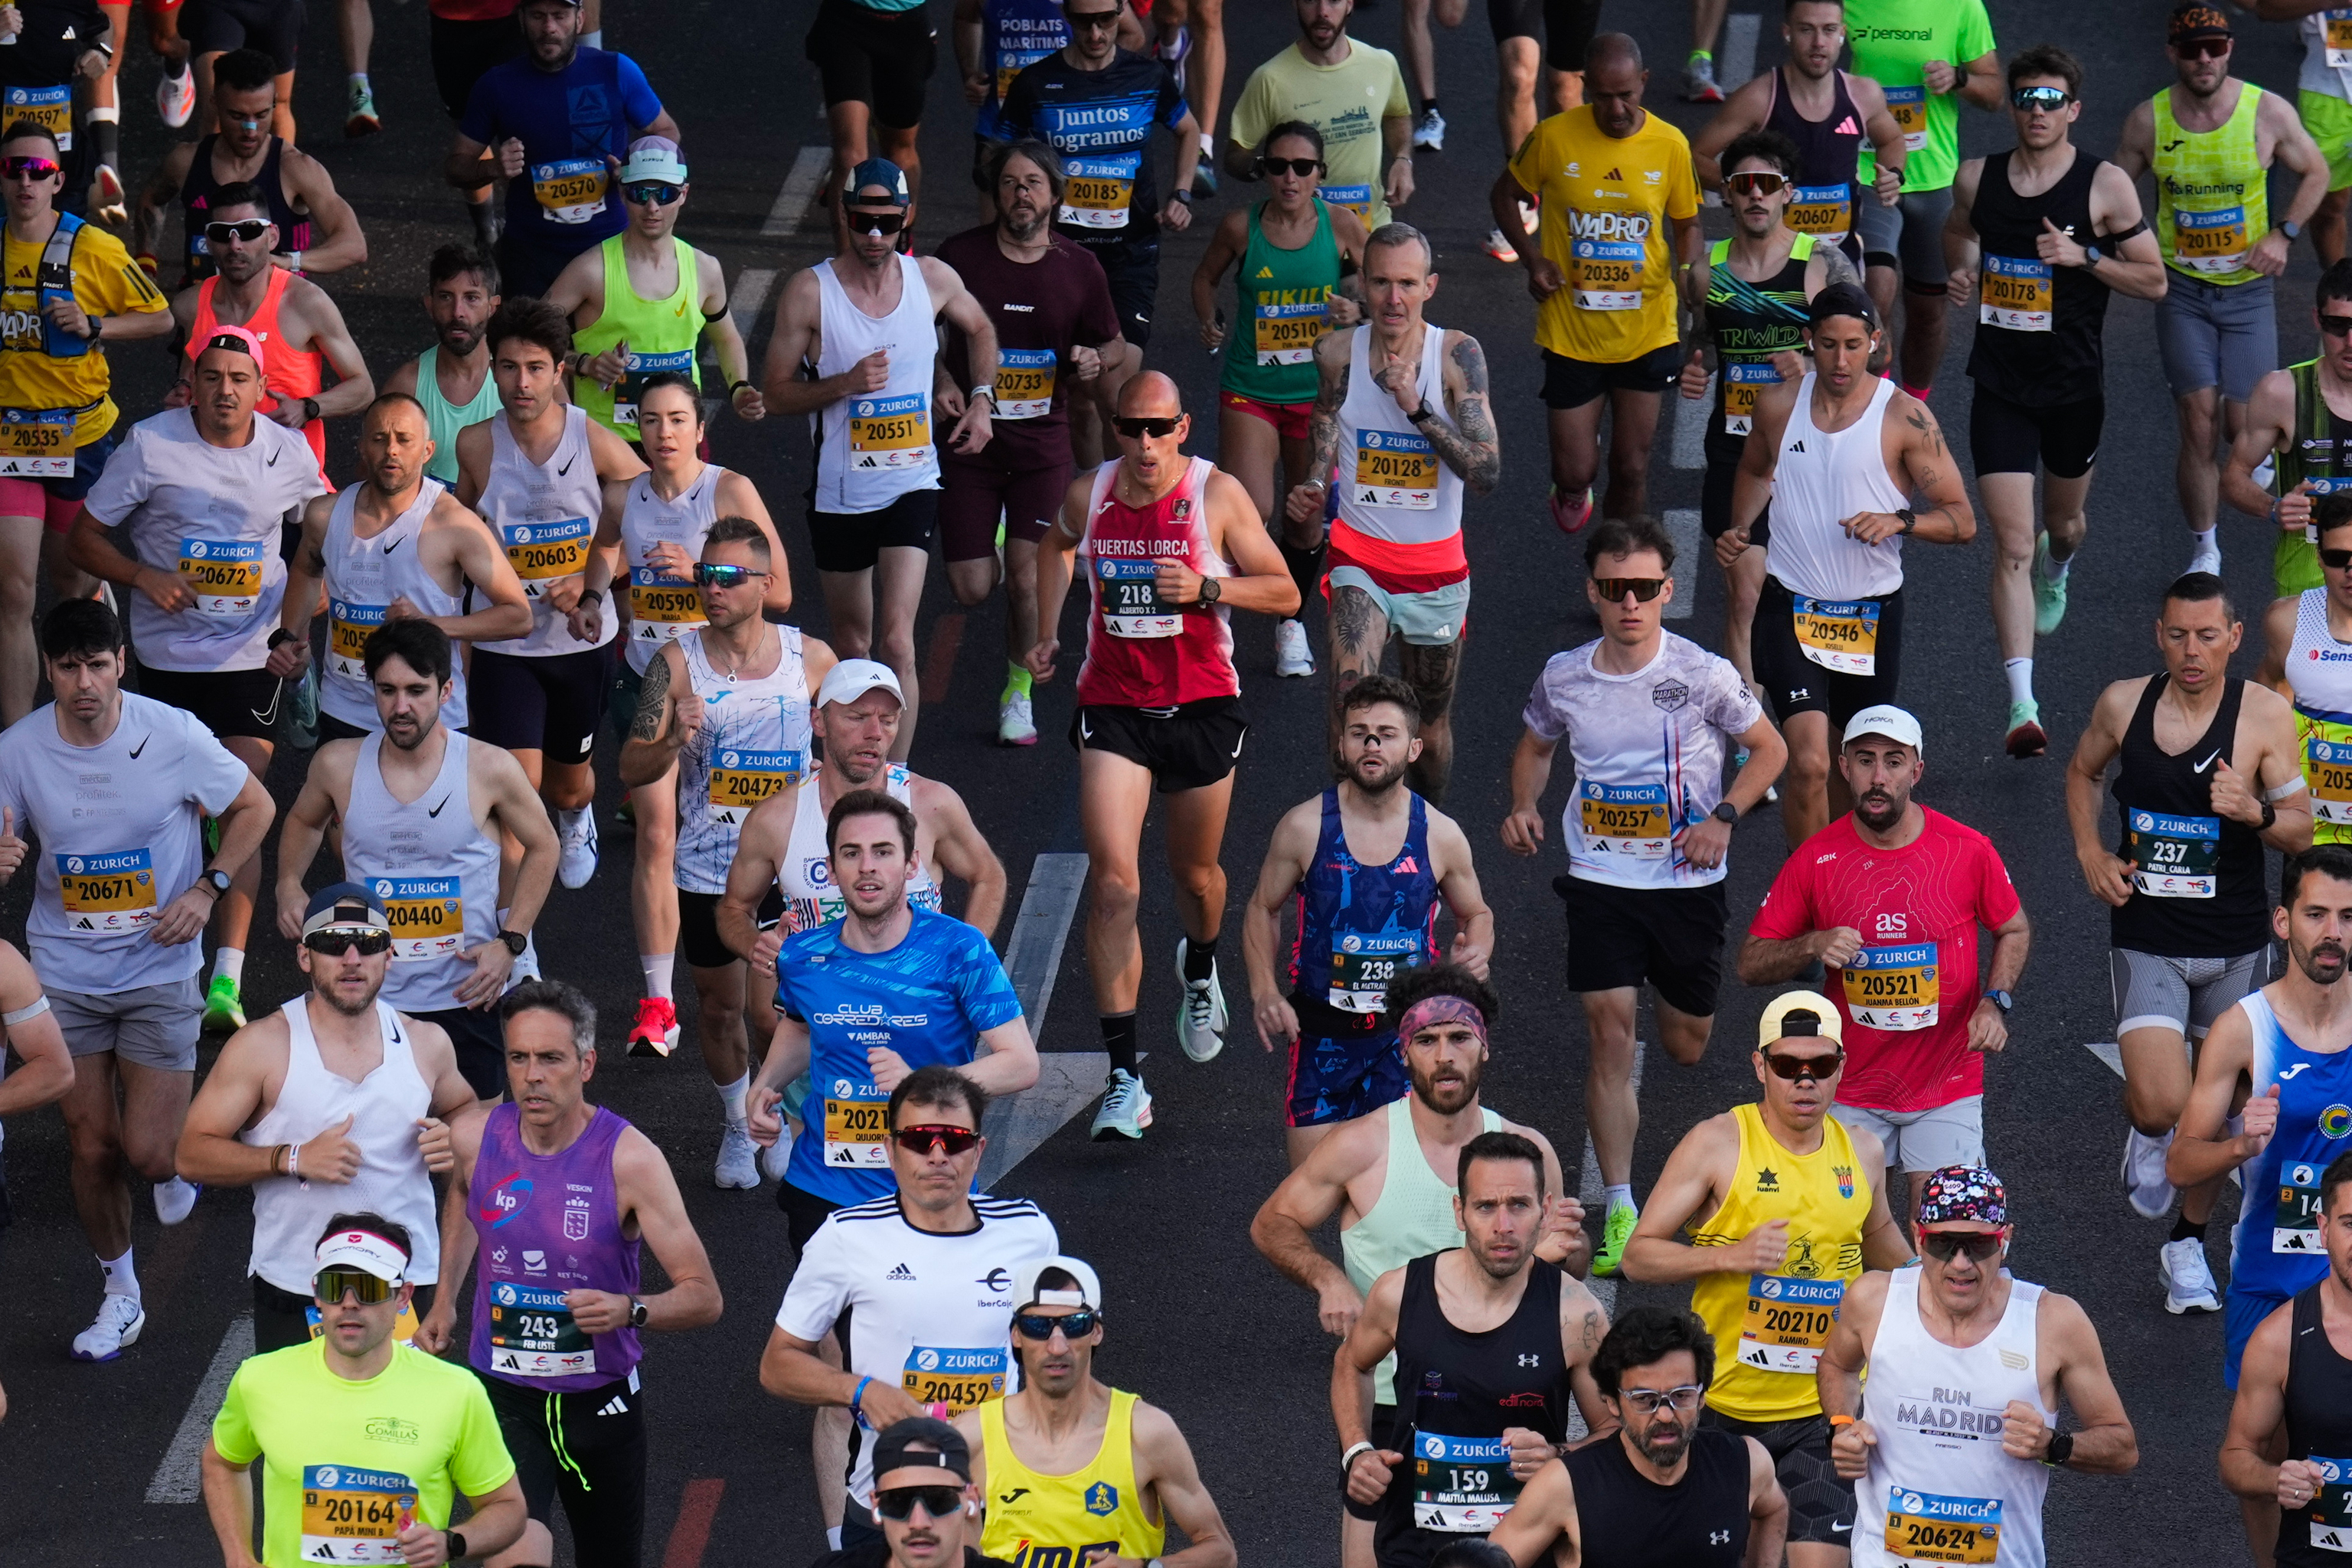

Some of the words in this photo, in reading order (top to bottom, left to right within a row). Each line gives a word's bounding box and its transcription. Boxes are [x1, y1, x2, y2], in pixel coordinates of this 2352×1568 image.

[1001, 19, 1063, 32] POBLATS
[1000, 34, 1067, 50] MARÍTIMS
[1871, 28, 1932, 41] personal
[31, 90, 64, 102] ZURICH
[1884, 91, 1916, 100] URICH
[1056, 107, 1130, 131] Juntos
[1046, 126, 1145, 153] logramos
[557, 159, 596, 175] ZURICH
[1086, 165, 1126, 176] ZURICH
[550, 179, 596, 199] 20570
[1073, 183, 1119, 200] 20185
[1326, 191, 1364, 201] ZURICH
[1807, 189, 1844, 201] ZURICH
[1793, 208, 1838, 224] 20607
[2197, 212, 2236, 224] ZURICH
[1568, 211, 1650, 243] MADRID
[2187, 231, 2231, 249] 20115
[1597, 247, 1638, 256] ZURICH
[1584, 265, 1629, 282] 20336
[2003, 262, 2043, 274] ZURICH
[1994, 280, 2036, 301] 20178
[1003, 303, 1034, 313] BANDIT
[1283, 303, 1325, 314] ZURICH
[1272, 322, 1318, 341] 20510
[1719, 324, 1800, 347] TRIWILD
[645, 356, 686, 368] ZURICH
[1009, 354, 1050, 364] ZURICH
[996, 373, 1041, 390] 20733
[1746, 369, 1782, 380] ZURIC
[880, 397, 919, 412] ZURICH
[14, 430, 59, 446] 20535
[867, 420, 913, 440] 20551
[1386, 436, 1430, 449] ZURICH
[1371, 457, 1421, 477] 20128
[536, 524, 581, 539] ZURICH
[212, 547, 255, 558] ZURICH
[1093, 540, 1145, 557] PUERTAS
[1149, 539, 1190, 556] LORCA
[526, 546, 577, 568] 20603
[195, 565, 246, 585] 20672
[1121, 564, 1162, 575] ZURIC
[646, 593, 696, 611] 20590
[1120, 585, 1153, 605] 218
[350, 609, 386, 621] ZURIC
[1825, 605, 1870, 615] ZURIH
[1810, 621, 1859, 642] 20546
[1654, 688, 1688, 699] MARATHON
[744, 755, 792, 766] ZURICH
[728, 776, 782, 796] 20473
[1609, 786, 1656, 799] ZURICH
[1598, 808, 1649, 827] 20257
[2158, 819, 2208, 835] ZURICH
[1816, 852, 1837, 864] 42K
[2153, 841, 2188, 863] 237
[90, 854, 140, 871] ZURICH
[1863, 860, 1875, 871] 21K
[77, 879, 133, 900] 20671
[399, 881, 449, 895] ZURICH
[386, 905, 443, 926] 20440
[1876, 913, 1907, 932] as
[1367, 938, 1413, 950] ZURICH
[1875, 949, 1927, 964] ZURICH
[1361, 961, 1395, 981] 238
[1862, 975, 1918, 998] 20521
[1866, 997, 1892, 1007] JUANMA
[1894, 995, 1920, 1005] BELLÓN
[838, 1004, 883, 1016] CLUB
[855, 1032, 892, 1041] AMBAR
[843, 1109, 889, 1130] 2021
[566, 1184, 593, 1194] VESKIN
[495, 1190, 517, 1211] kp
[573, 1272, 588, 1281] SILO
[521, 1292, 567, 1306] ZURIC
[1788, 1285, 1841, 1299] ZURICH
[519, 1315, 559, 1338] 243
[1765, 1308, 1828, 1334] 20210
[523, 1339, 536, 1349] FER
[1778, 1335, 1808, 1345] RAMIRO
[945, 1355, 999, 1367] ZURICH
[923, 1381, 988, 1404] 20452
[1932, 1387, 1971, 1406] RUN
[1897, 1403, 2003, 1434] MADRID
[1452, 1442, 1511, 1458] ZURICH
[345, 1472, 406, 1488] ZURICH
[1449, 1469, 1489, 1491] 159
[1437, 1491, 1465, 1503] MATTIA
[1467, 1492, 1501, 1503] MALUSA
[325, 1498, 394, 1524] 20164
[1929, 1500, 1989, 1517] ZURICH
[334, 1524, 354, 1536] PAPÁ
[357, 1526, 376, 1537] MINI
[1906, 1524, 1975, 1549] 20624
[1913, 1549, 1942, 1560] MIGUEL
[1944, 1551, 1965, 1561] GUTI
